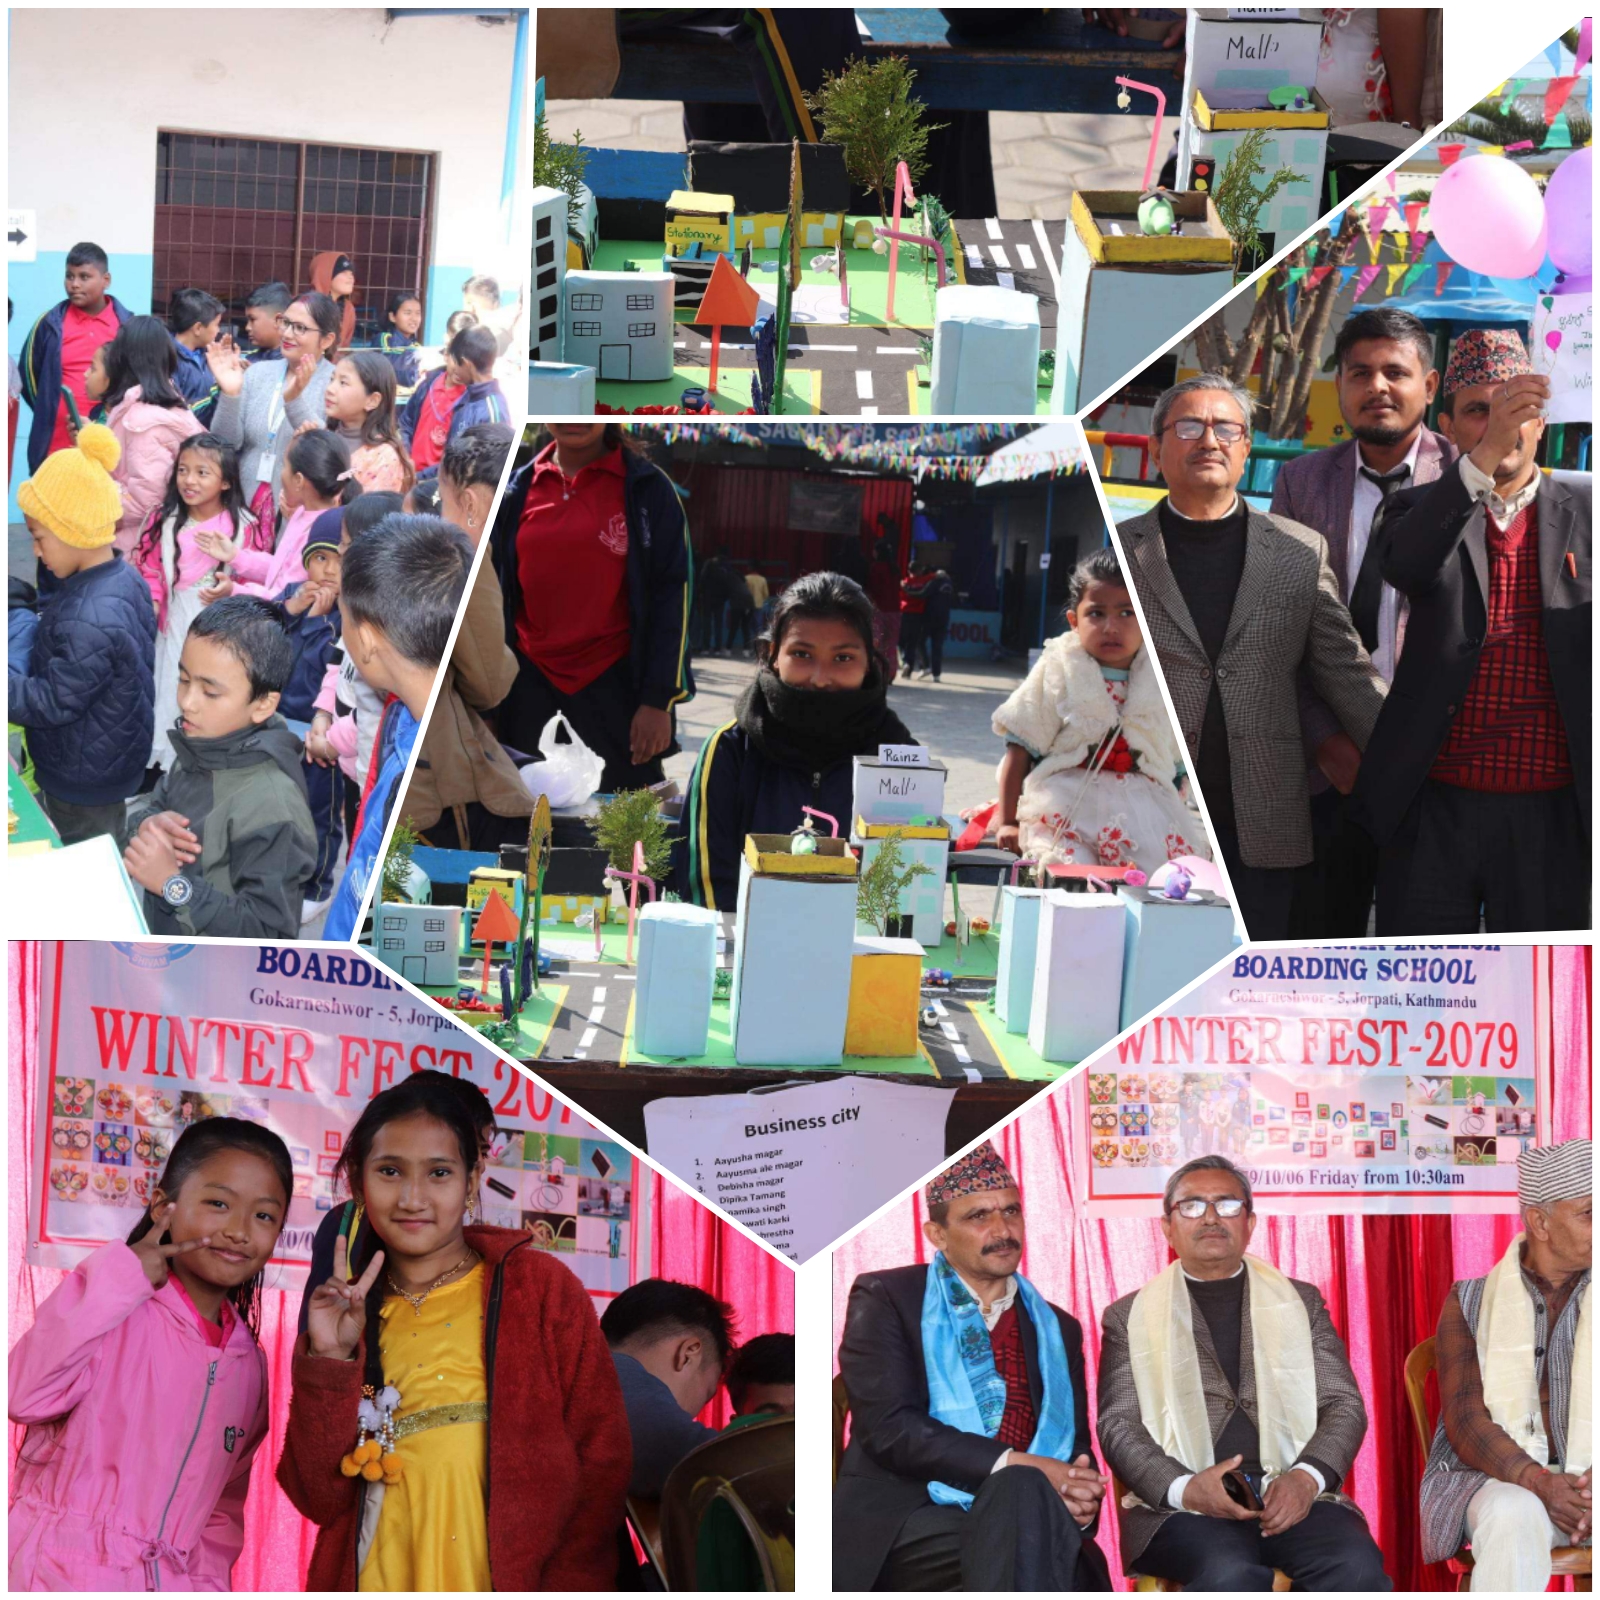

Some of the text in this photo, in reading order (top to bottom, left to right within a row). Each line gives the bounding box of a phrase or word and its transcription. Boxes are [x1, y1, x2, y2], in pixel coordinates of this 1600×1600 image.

[883, 748, 920, 762] Rainz
[1232, 955, 1477, 985] BOARDING SCHOOL
[249, 987, 374, 1019] Gokarneshwor
[1405, 992, 1478, 1009] Kathmandu
[91, 1005, 316, 1091] WINTER
[1299, 1017, 1520, 1070] FEST-2079
[744, 1105, 861, 1138] Business city
[694, 1148, 783, 1166] 1. Aayusha magar
[696, 1172, 705, 1181] 2.
[716, 1167, 758, 1179] Aayusma
[774, 1159, 804, 1171] magar
[1309, 1168, 1360, 1188] Friday
[1364, 1168, 1400, 1185] from
[1405, 1169, 1465, 1185] 10:30am
[717, 1180, 754, 1192] Debisha
[756, 1176, 784, 1188] magar
[719, 1190, 786, 1205] Dipika Tamang
[762, 1203, 786, 1213] singh
[768, 1214, 790, 1225] karki
